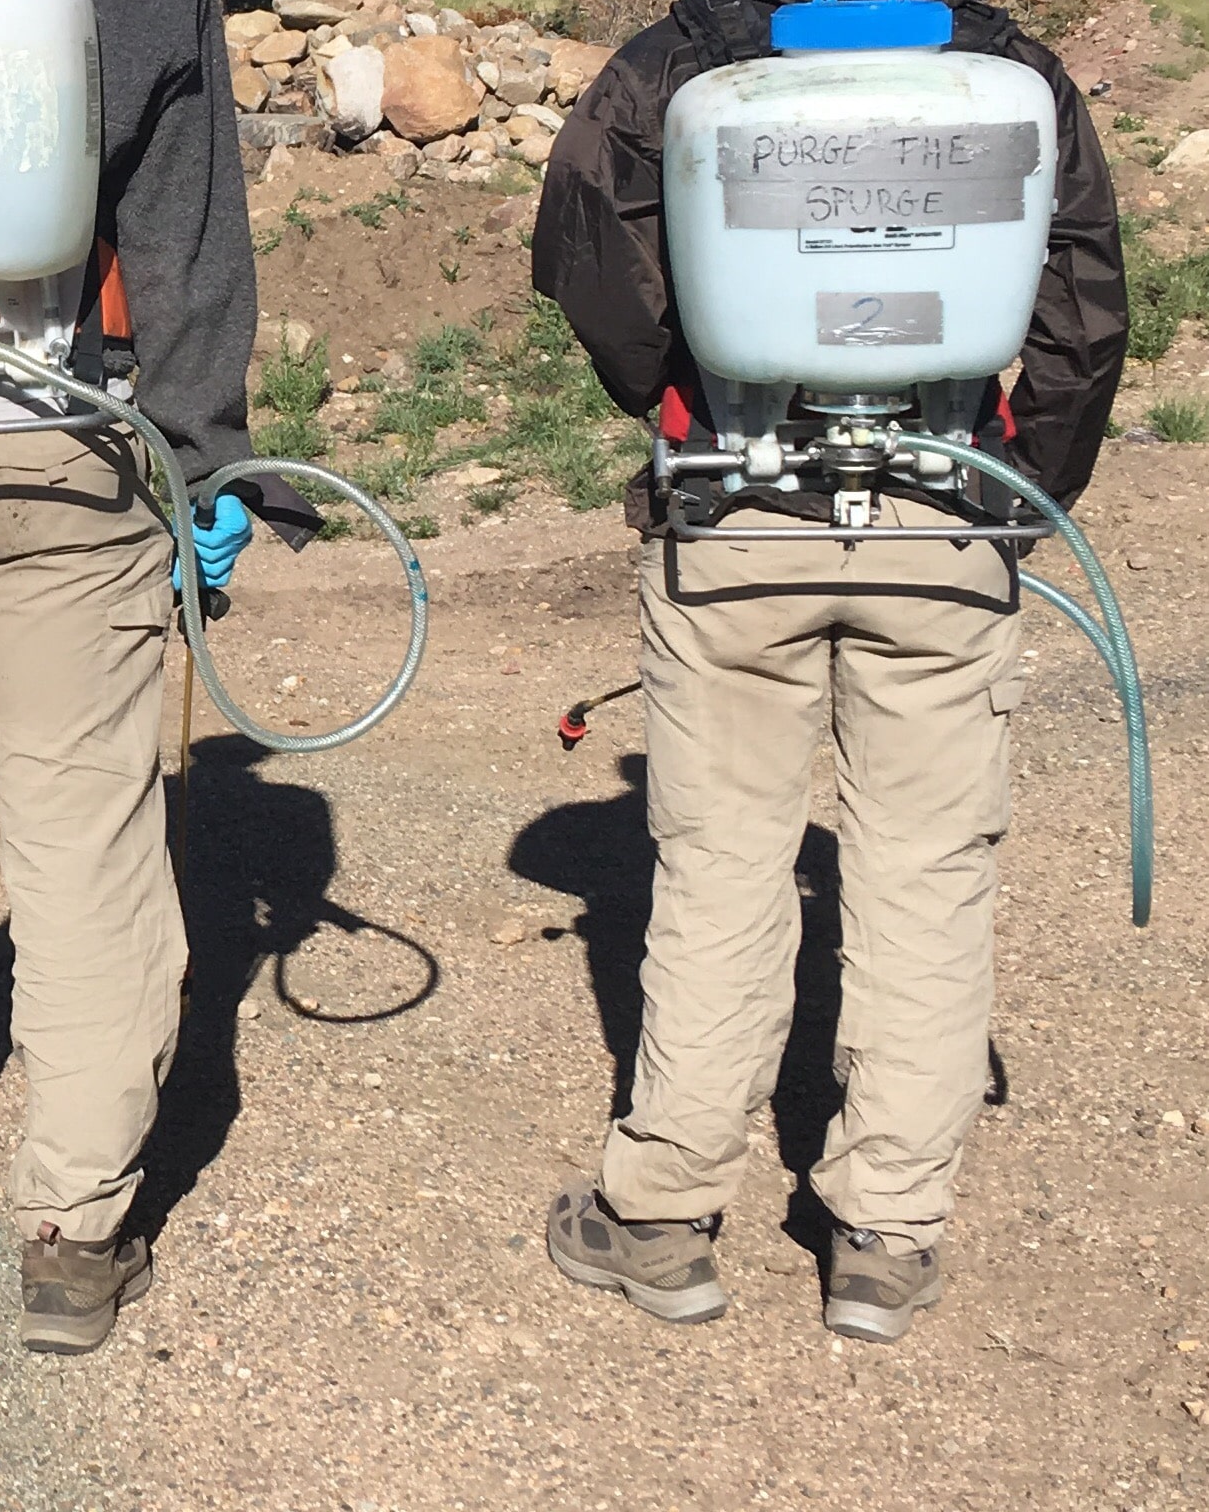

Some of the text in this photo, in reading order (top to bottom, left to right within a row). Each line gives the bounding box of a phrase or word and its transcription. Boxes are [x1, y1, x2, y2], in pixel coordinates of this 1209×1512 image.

[752, 134, 974, 174] PURGE THE
[806, 185, 944, 221] SPURGE
